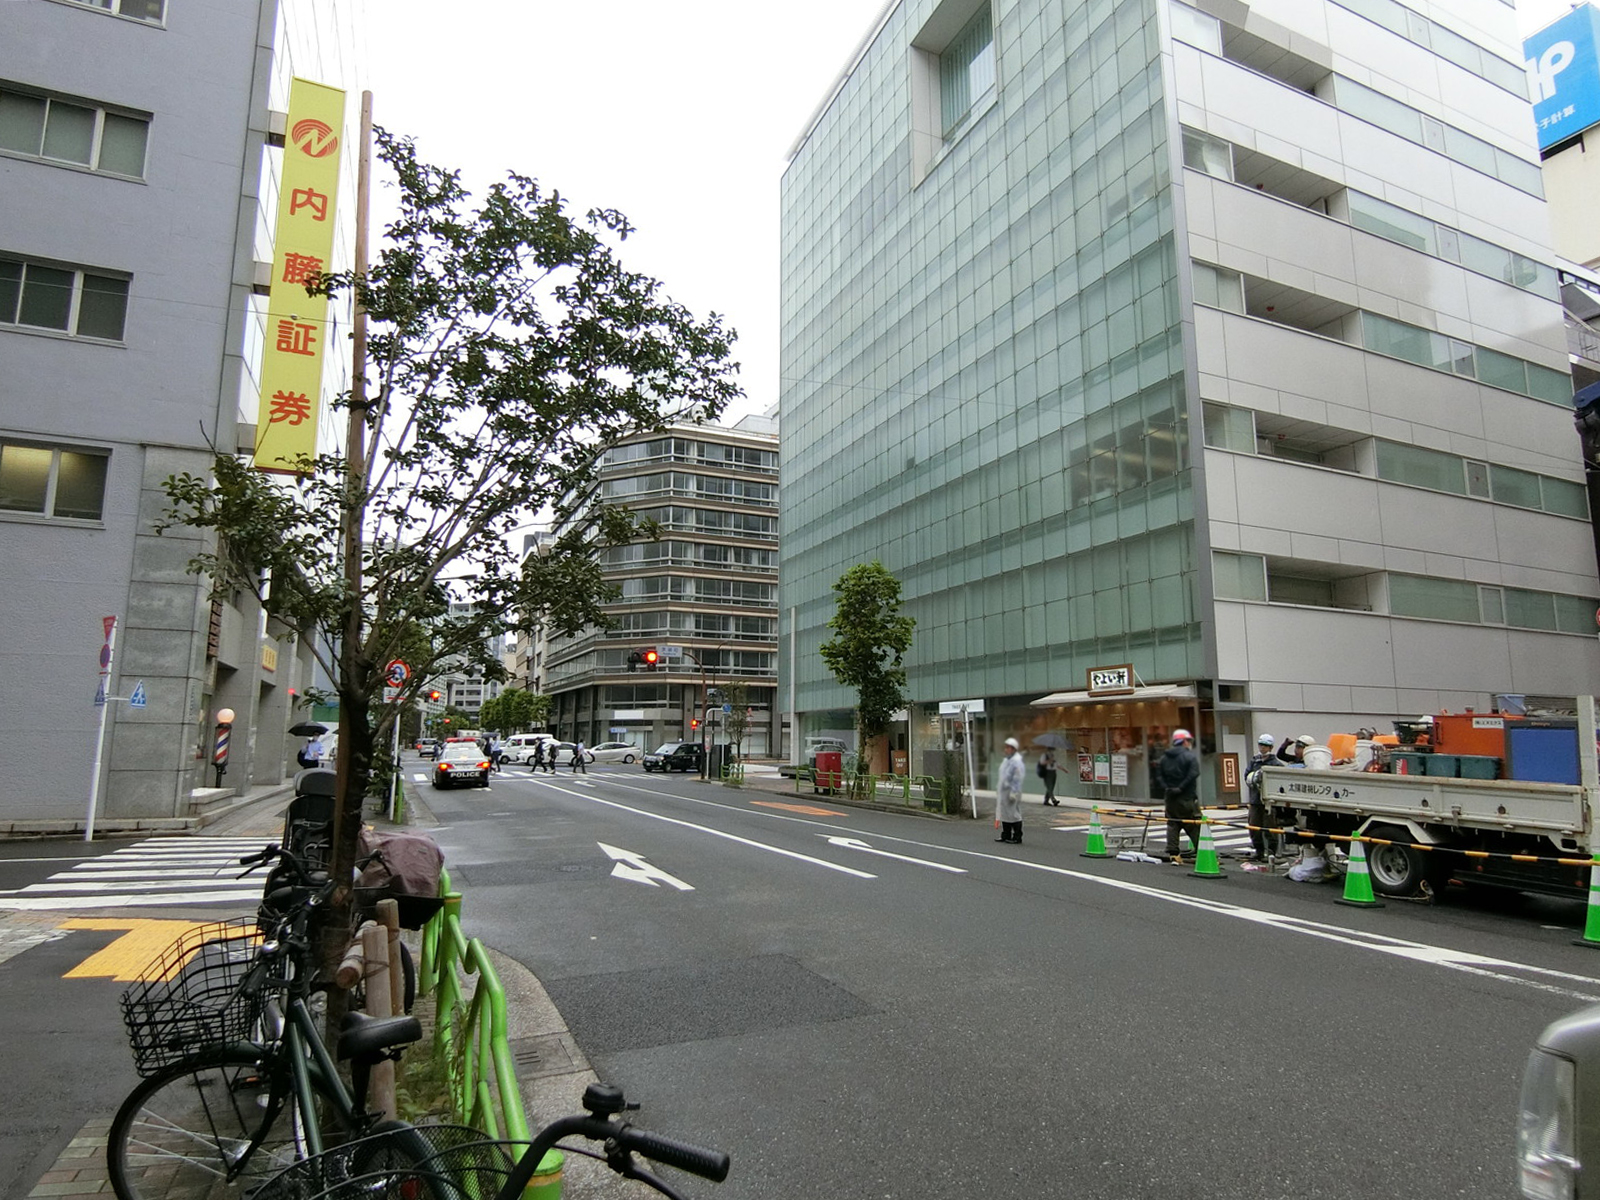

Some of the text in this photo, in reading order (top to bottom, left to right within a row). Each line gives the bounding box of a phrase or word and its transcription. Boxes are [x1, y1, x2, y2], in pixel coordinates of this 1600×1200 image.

[1536, 104, 1576, 131] 子計算
[268, 187, 328, 426] 内藤証券
[1092, 671, 1126, 685] やよい軒
